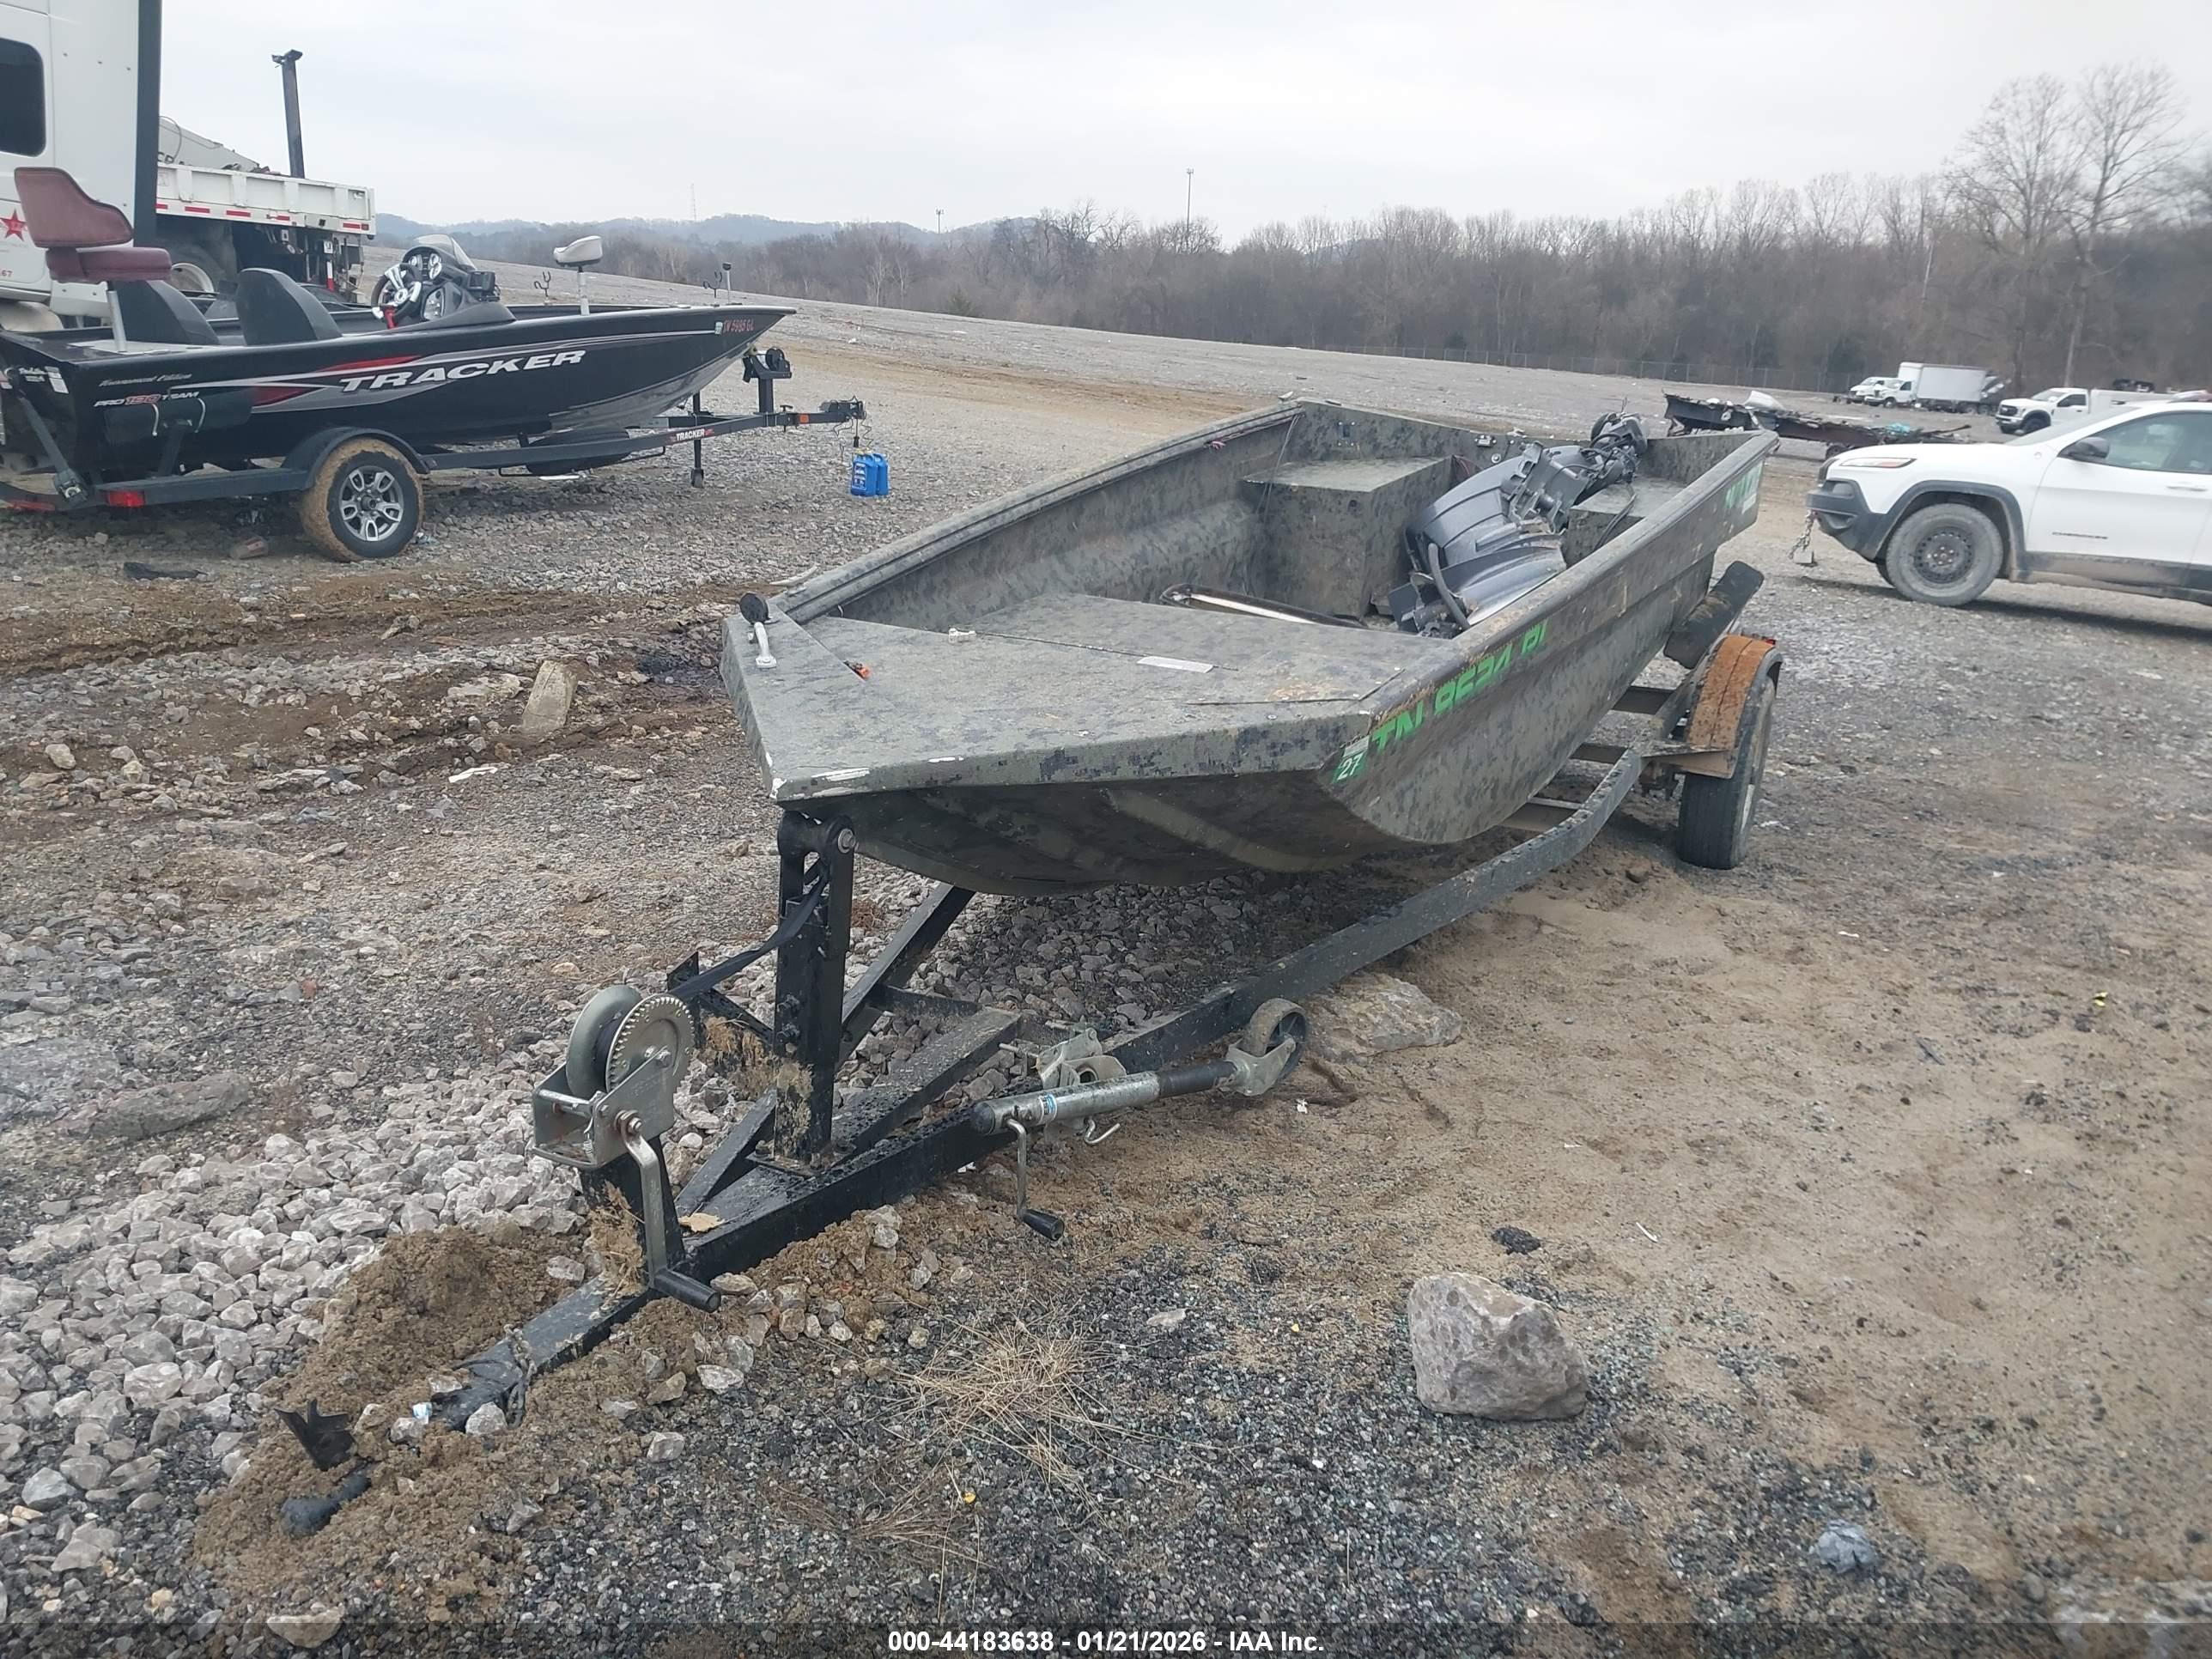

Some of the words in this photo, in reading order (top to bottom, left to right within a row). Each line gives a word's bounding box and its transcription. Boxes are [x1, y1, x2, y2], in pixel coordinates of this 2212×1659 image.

[338, 349, 586, 392] TRACKER
[675, 428, 705, 441] TRACKER
[1337, 753, 1364, 781] 27
